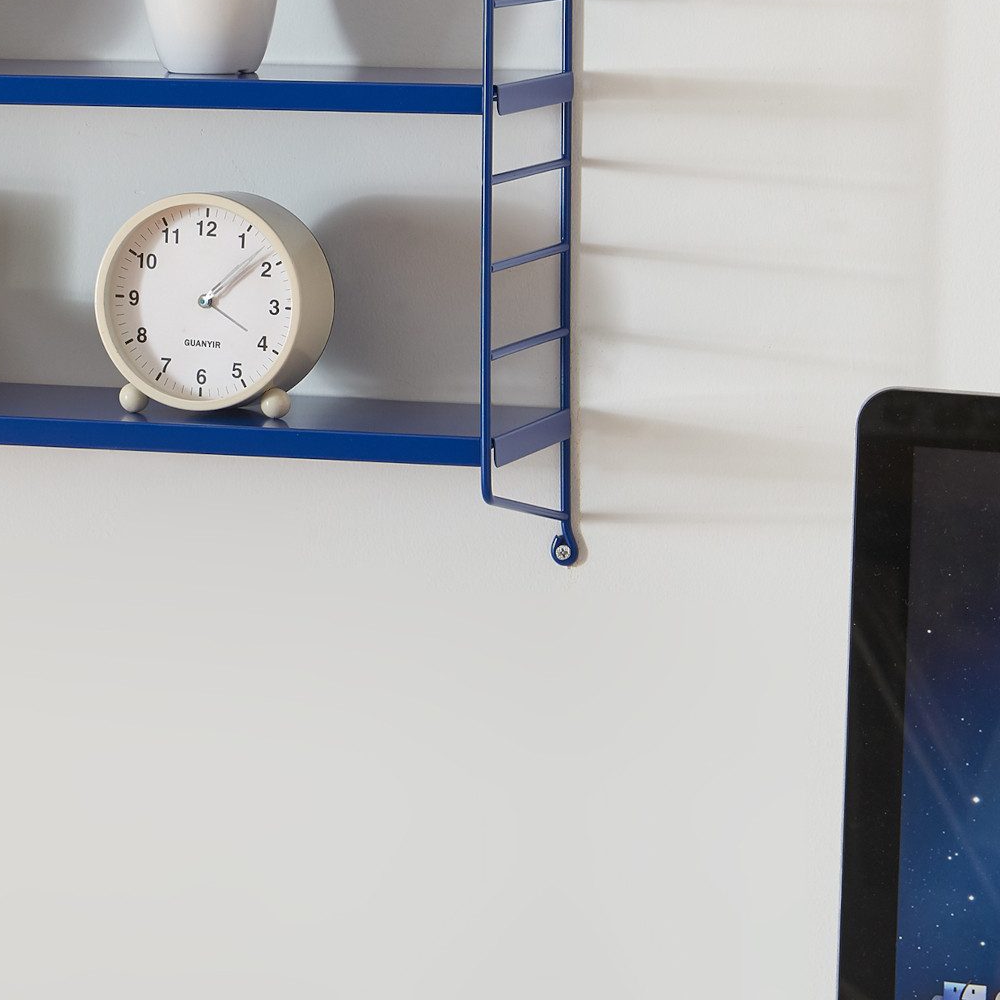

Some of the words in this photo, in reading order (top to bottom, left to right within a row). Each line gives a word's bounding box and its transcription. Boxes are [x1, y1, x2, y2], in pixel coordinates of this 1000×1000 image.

[162, 228, 179, 244] 11
[196, 221, 217, 237] 12
[238, 233, 245, 248] 1
[137, 253, 157, 269] 10
[261, 262, 272, 277] 2
[129, 290, 139, 305] 9
[269, 300, 279, 315] 3
[137, 327, 147, 343] 8
[184, 339, 221, 348] GUANYIR
[257, 336, 268, 351] 4
[161, 358, 172, 373] 7
[232, 363, 242, 378] 5
[196, 369, 207, 384] 6
